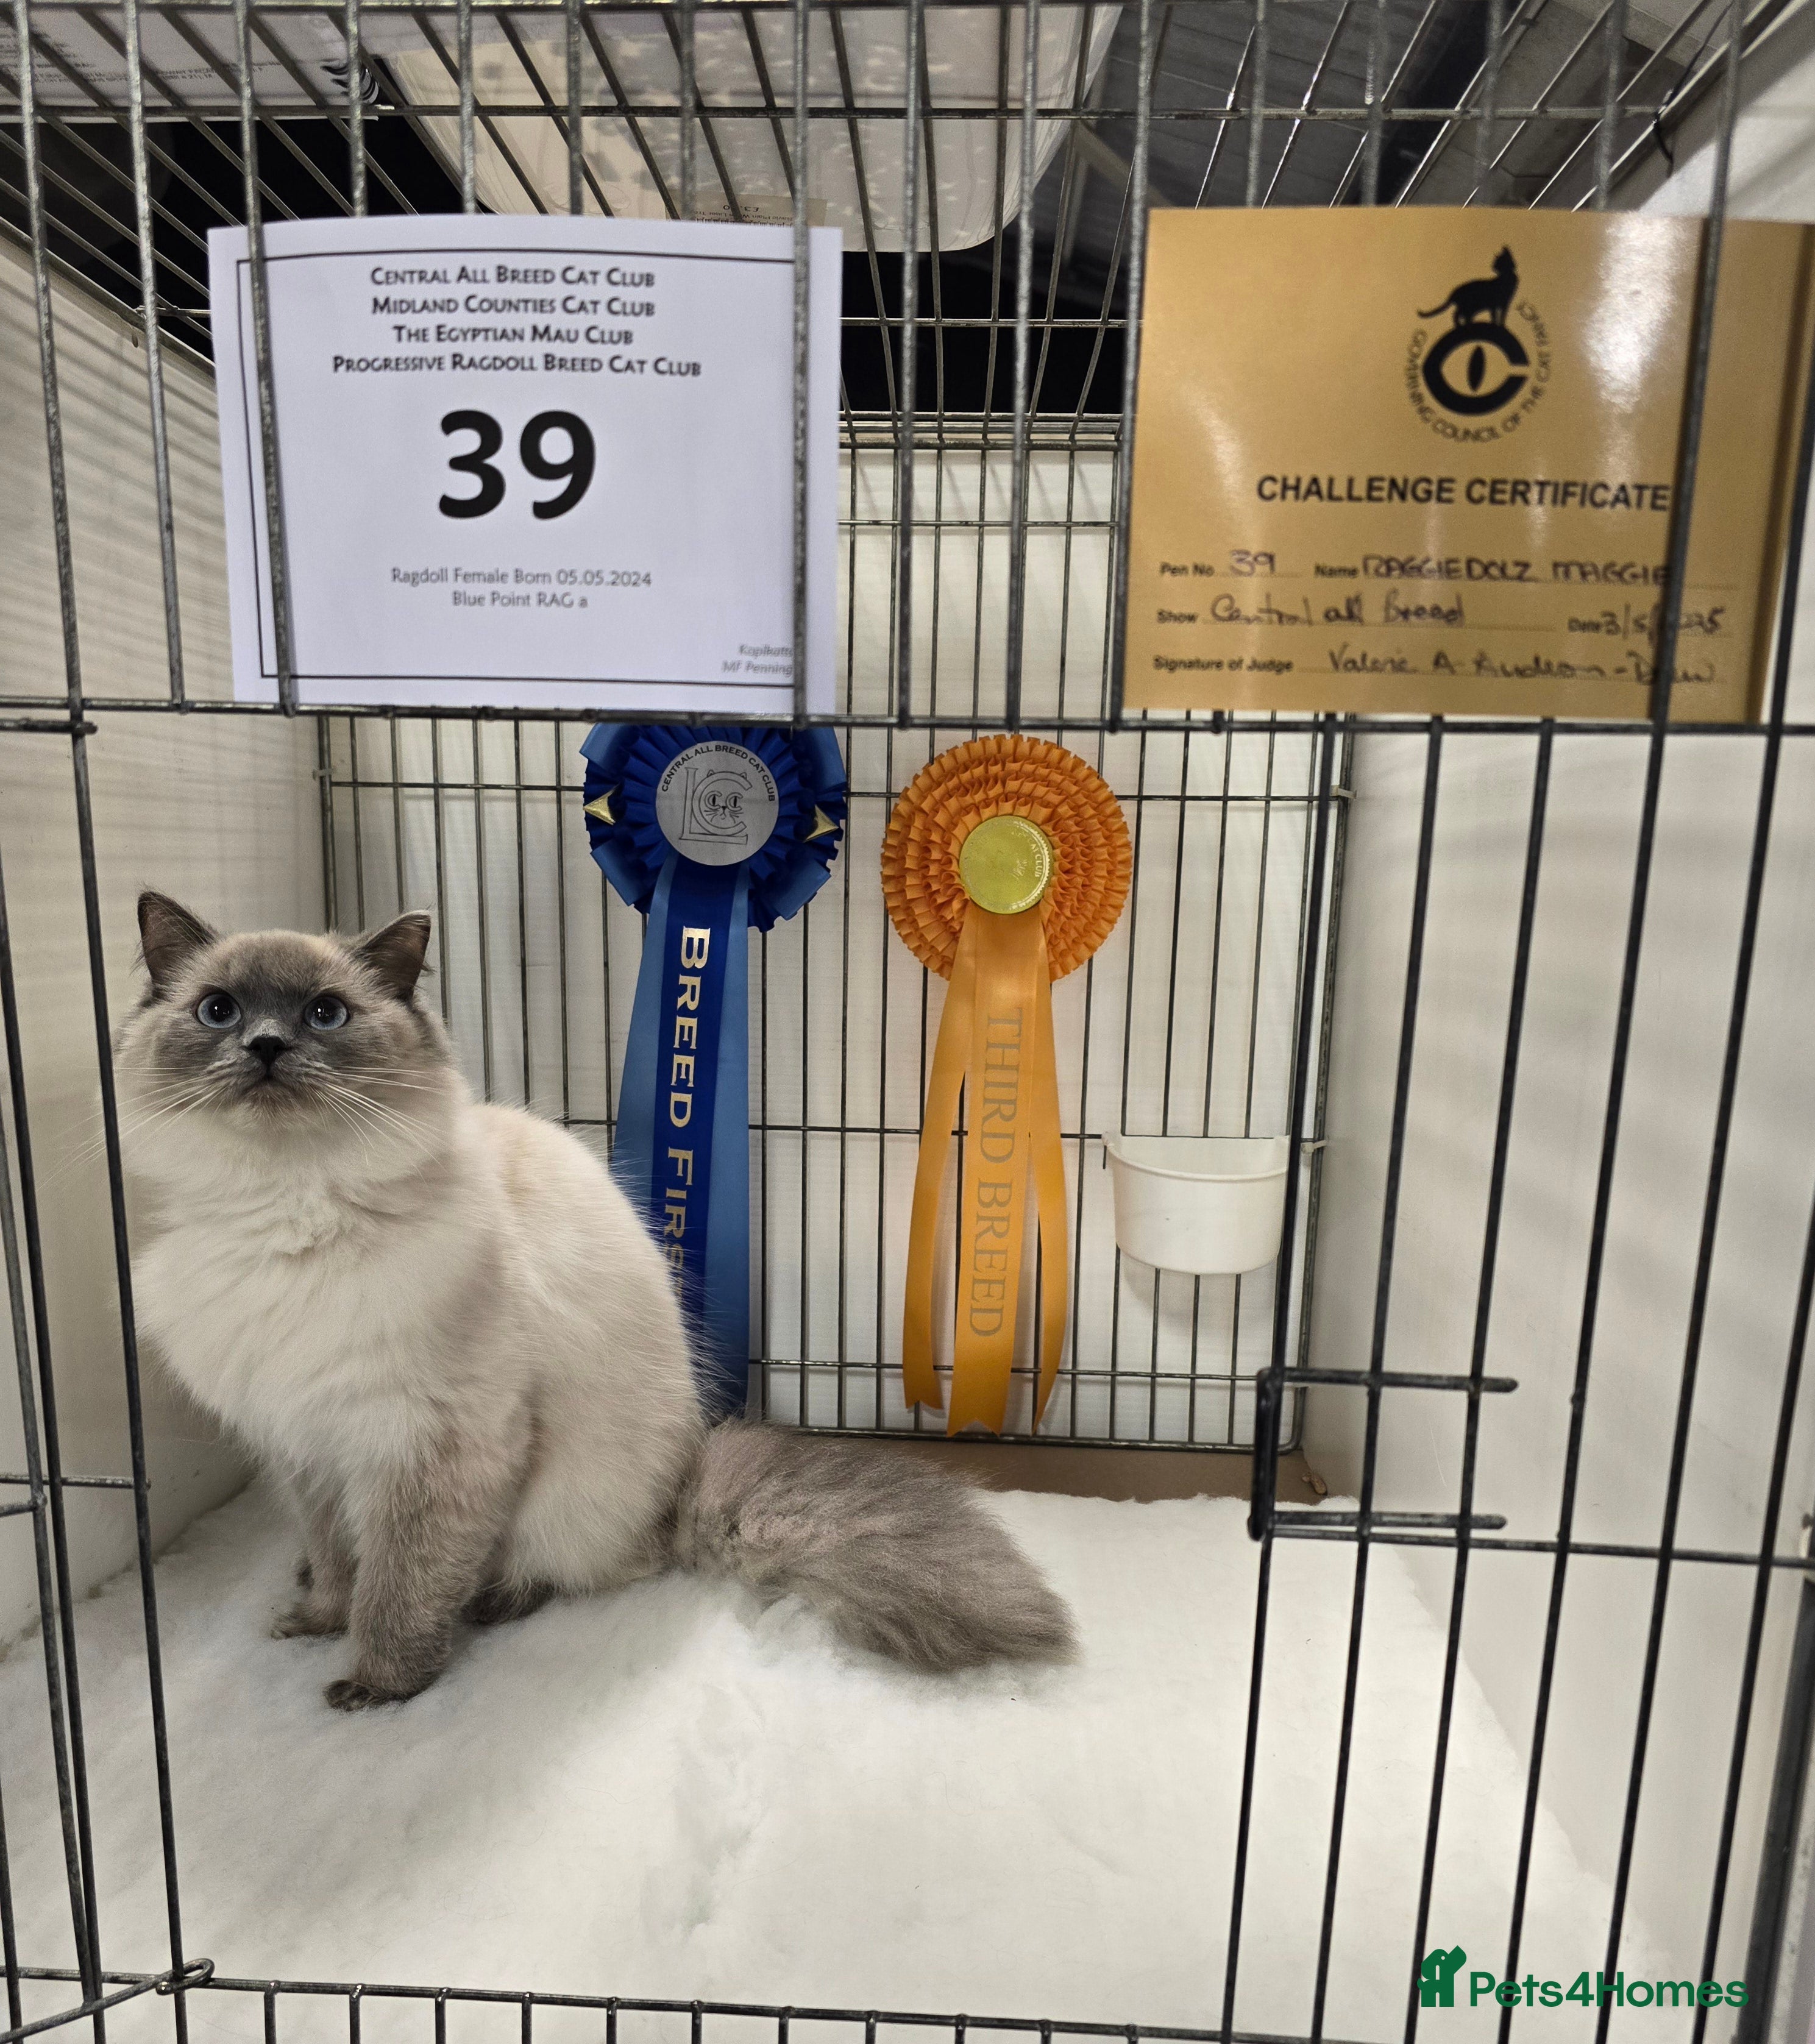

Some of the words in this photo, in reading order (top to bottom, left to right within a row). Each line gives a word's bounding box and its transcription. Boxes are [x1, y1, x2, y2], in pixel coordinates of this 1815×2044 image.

[371, 266, 452, 286] CENTRAL
[456, 266, 489, 284] ALL
[495, 265, 556, 284] BREED
[561, 267, 601, 286] CAT
[606, 268, 656, 287] CLUB
[371, 297, 458, 314] MIDLAND
[464, 295, 556, 314] COUNTIES
[561, 296, 601, 315] CAT
[606, 297, 656, 316] CLUB
[392, 325, 430, 342] THE
[436, 325, 524, 344] EGYPTIAN
[531, 325, 579, 344] MAU
[585, 326, 634, 346] CLUB
[333, 355, 446, 373] PROGRESSIVE
[451, 354, 538, 372] RAGDOLL
[544, 355, 603, 374] BREED
[609, 356, 647, 375] CAT
[653, 357, 701, 377] CLUB
[439, 409, 597, 520] 39
[1256, 474, 1457, 504] CHALLENGE
[1465, 477, 1672, 513] CERTIFICATE
[1229, 548, 1276, 578] 39
[391, 567, 449, 588] Ragdoll
[453, 568, 510, 585] Female
[513, 568, 552, 585] Born
[555, 569, 653, 587] 05.05.2024
[452, 591, 486, 607] Blue
[491, 591, 531, 608] Point
[536, 591, 574, 608] RAG
[578, 595, 589, 608] a
[1153, 654, 1224, 673] Signature
[1227, 656, 1245, 672] of
[1246, 656, 1294, 675] Judge
[661, 753, 694, 792] CENTRAL
[694, 745, 714, 757] ALL
[714, 744, 748, 760] BREED
[748, 757, 765, 774] CAT
[762, 773, 776, 802] CLUB
[667, 925, 711, 1129] BREED
[980, 1006, 1023, 1165] THIRD
[969, 1177, 1014, 1338] BREED
